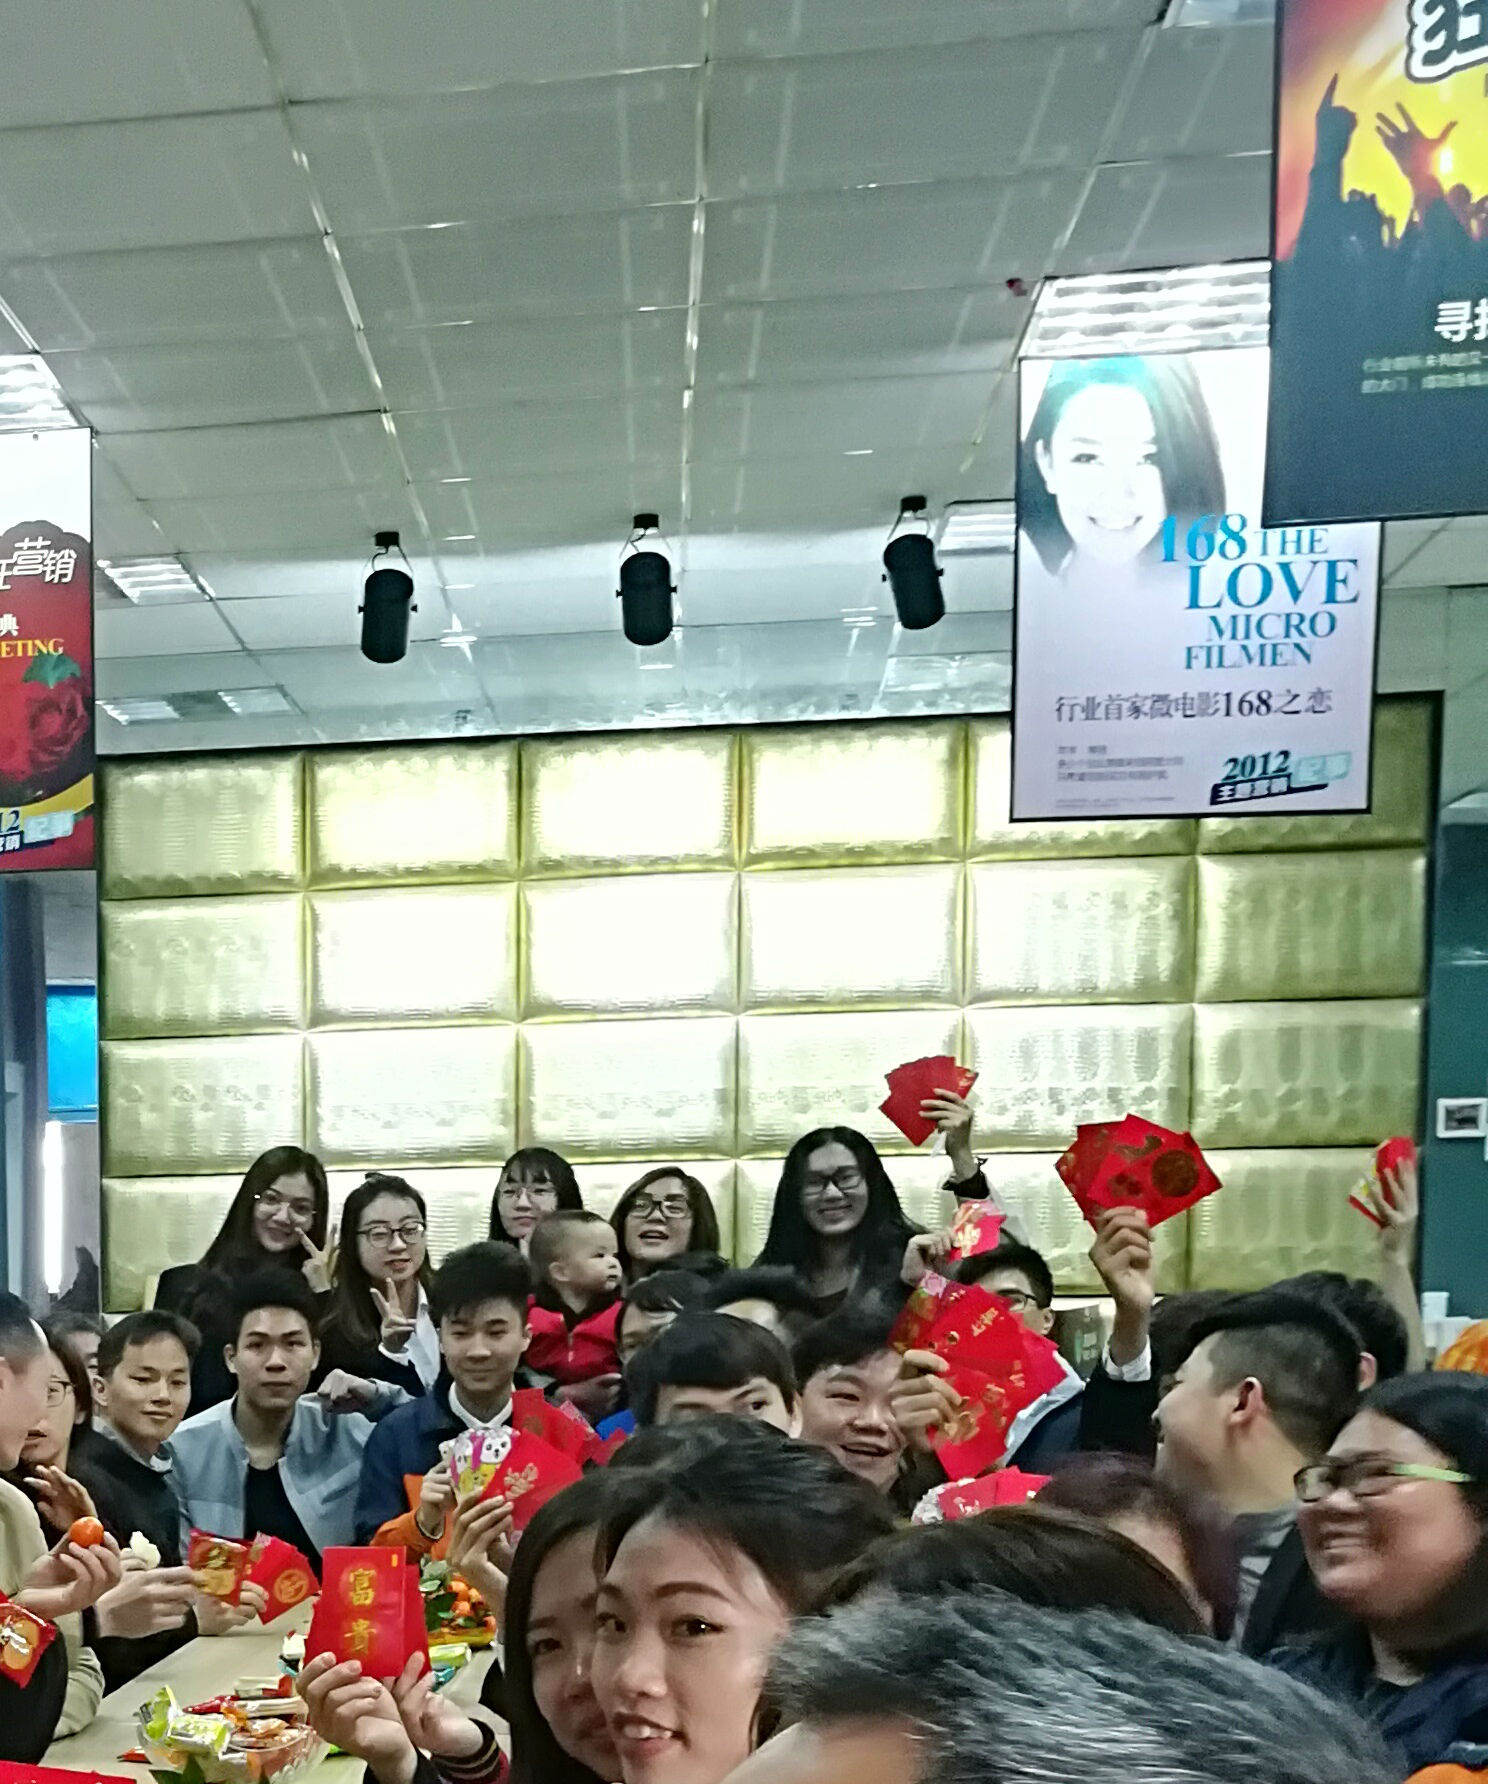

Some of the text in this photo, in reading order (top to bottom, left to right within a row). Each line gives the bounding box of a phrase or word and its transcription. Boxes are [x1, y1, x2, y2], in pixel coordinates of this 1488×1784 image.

[1159, 513, 1328, 562] 168 THE
[1185, 559, 1359, 609] LOVE
[1208, 611, 1337, 641] MICRO
[1185, 643, 1311, 669] FILMEN
[1221, 750, 1291, 781] 2012
